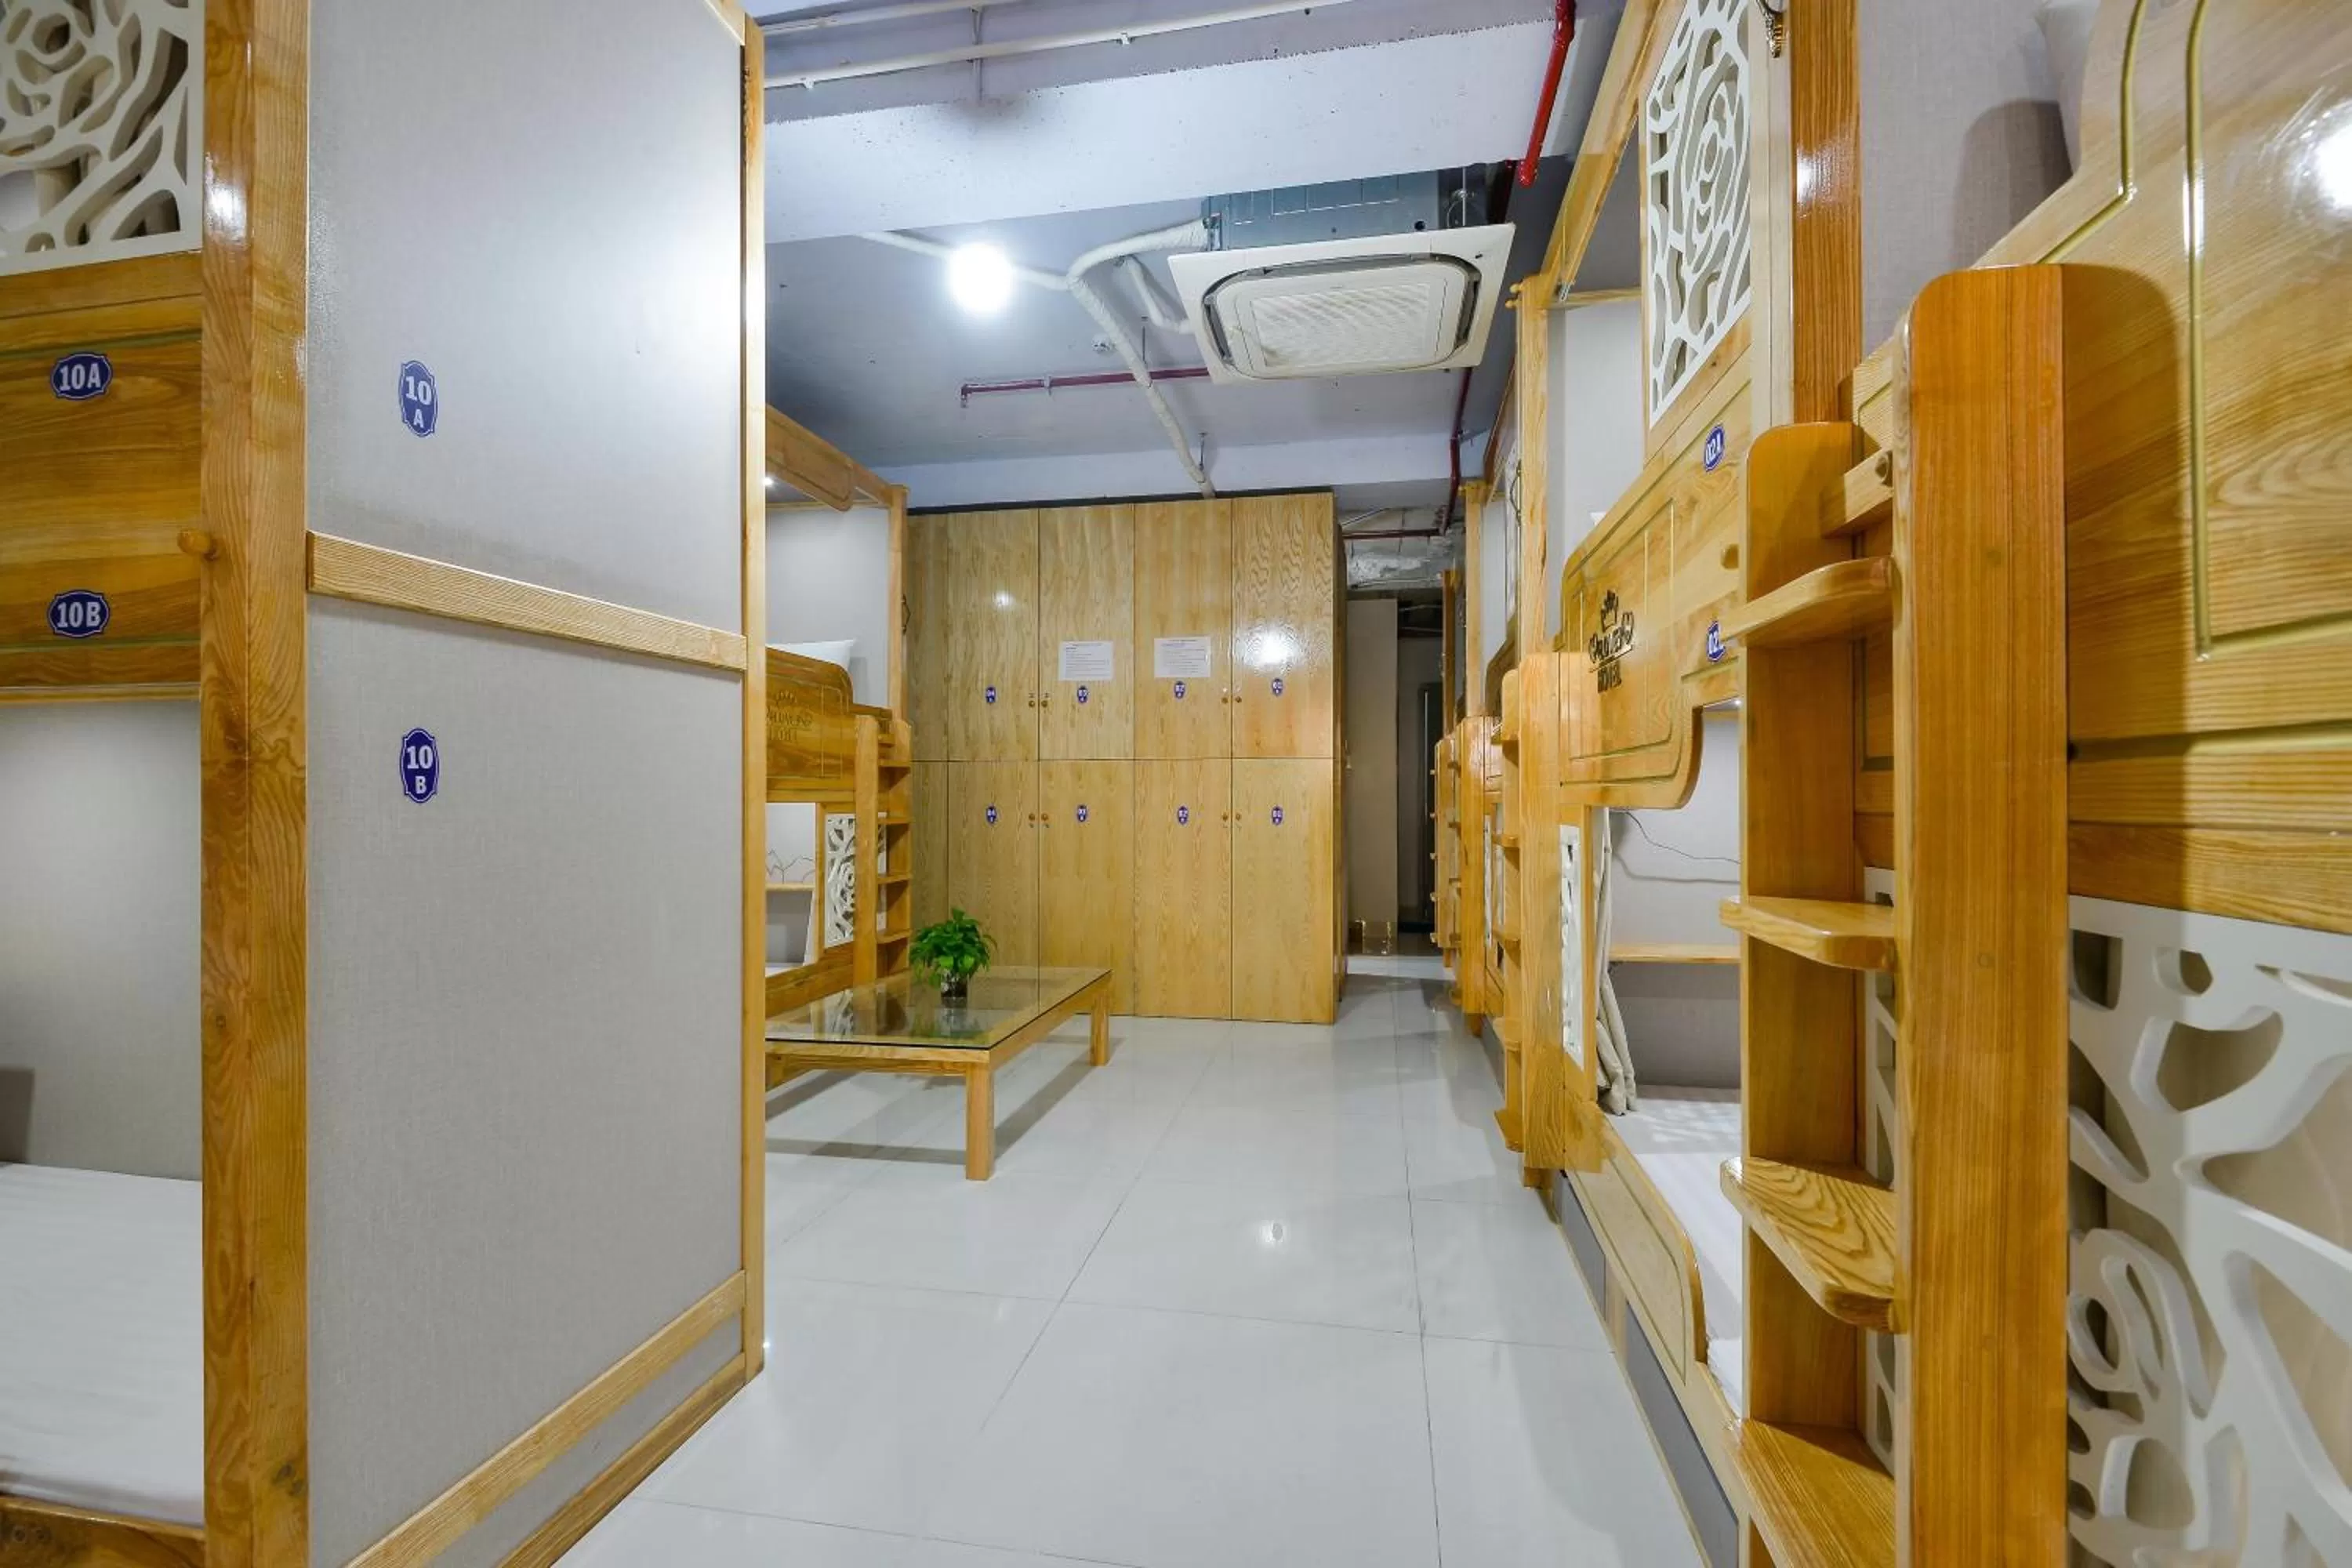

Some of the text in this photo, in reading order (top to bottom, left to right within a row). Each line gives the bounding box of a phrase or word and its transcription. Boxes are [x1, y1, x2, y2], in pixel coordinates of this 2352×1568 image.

[59, 362, 101, 392] 10A
[405, 379, 433, 406] 10
[412, 412, 425, 429] A
[56, 602, 101, 628] 10B
[405, 745, 434, 771] 10
[415, 775, 427, 794] B
